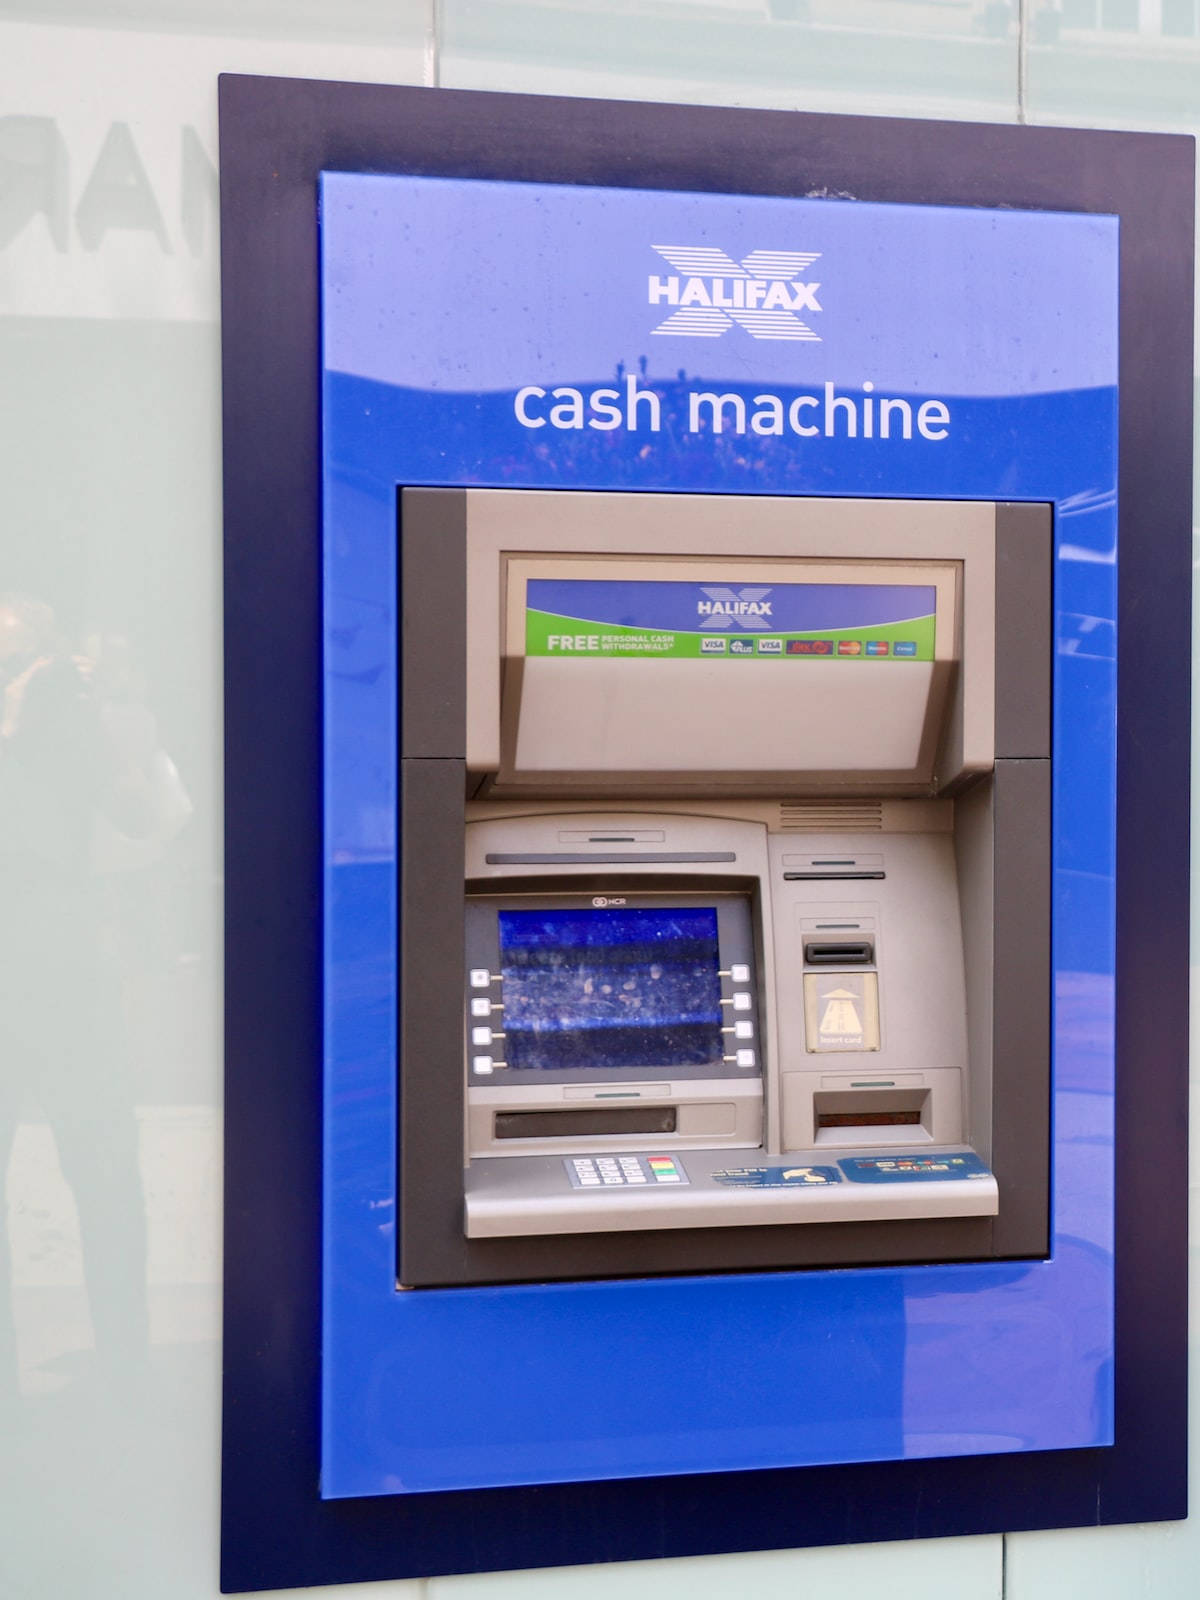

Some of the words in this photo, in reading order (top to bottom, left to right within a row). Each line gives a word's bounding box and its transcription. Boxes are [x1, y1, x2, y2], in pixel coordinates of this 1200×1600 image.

[648, 275, 823, 311] HALIFAX
[514, 375, 660, 432] cash
[689, 381, 950, 440] machine
[698, 601, 772, 616] HALIFAX
[547, 635, 599, 650] FREE
[602, 635, 648, 643] PERSONAL
[704, 640, 725, 649] VISA
[761, 641, 781, 650] VISA
